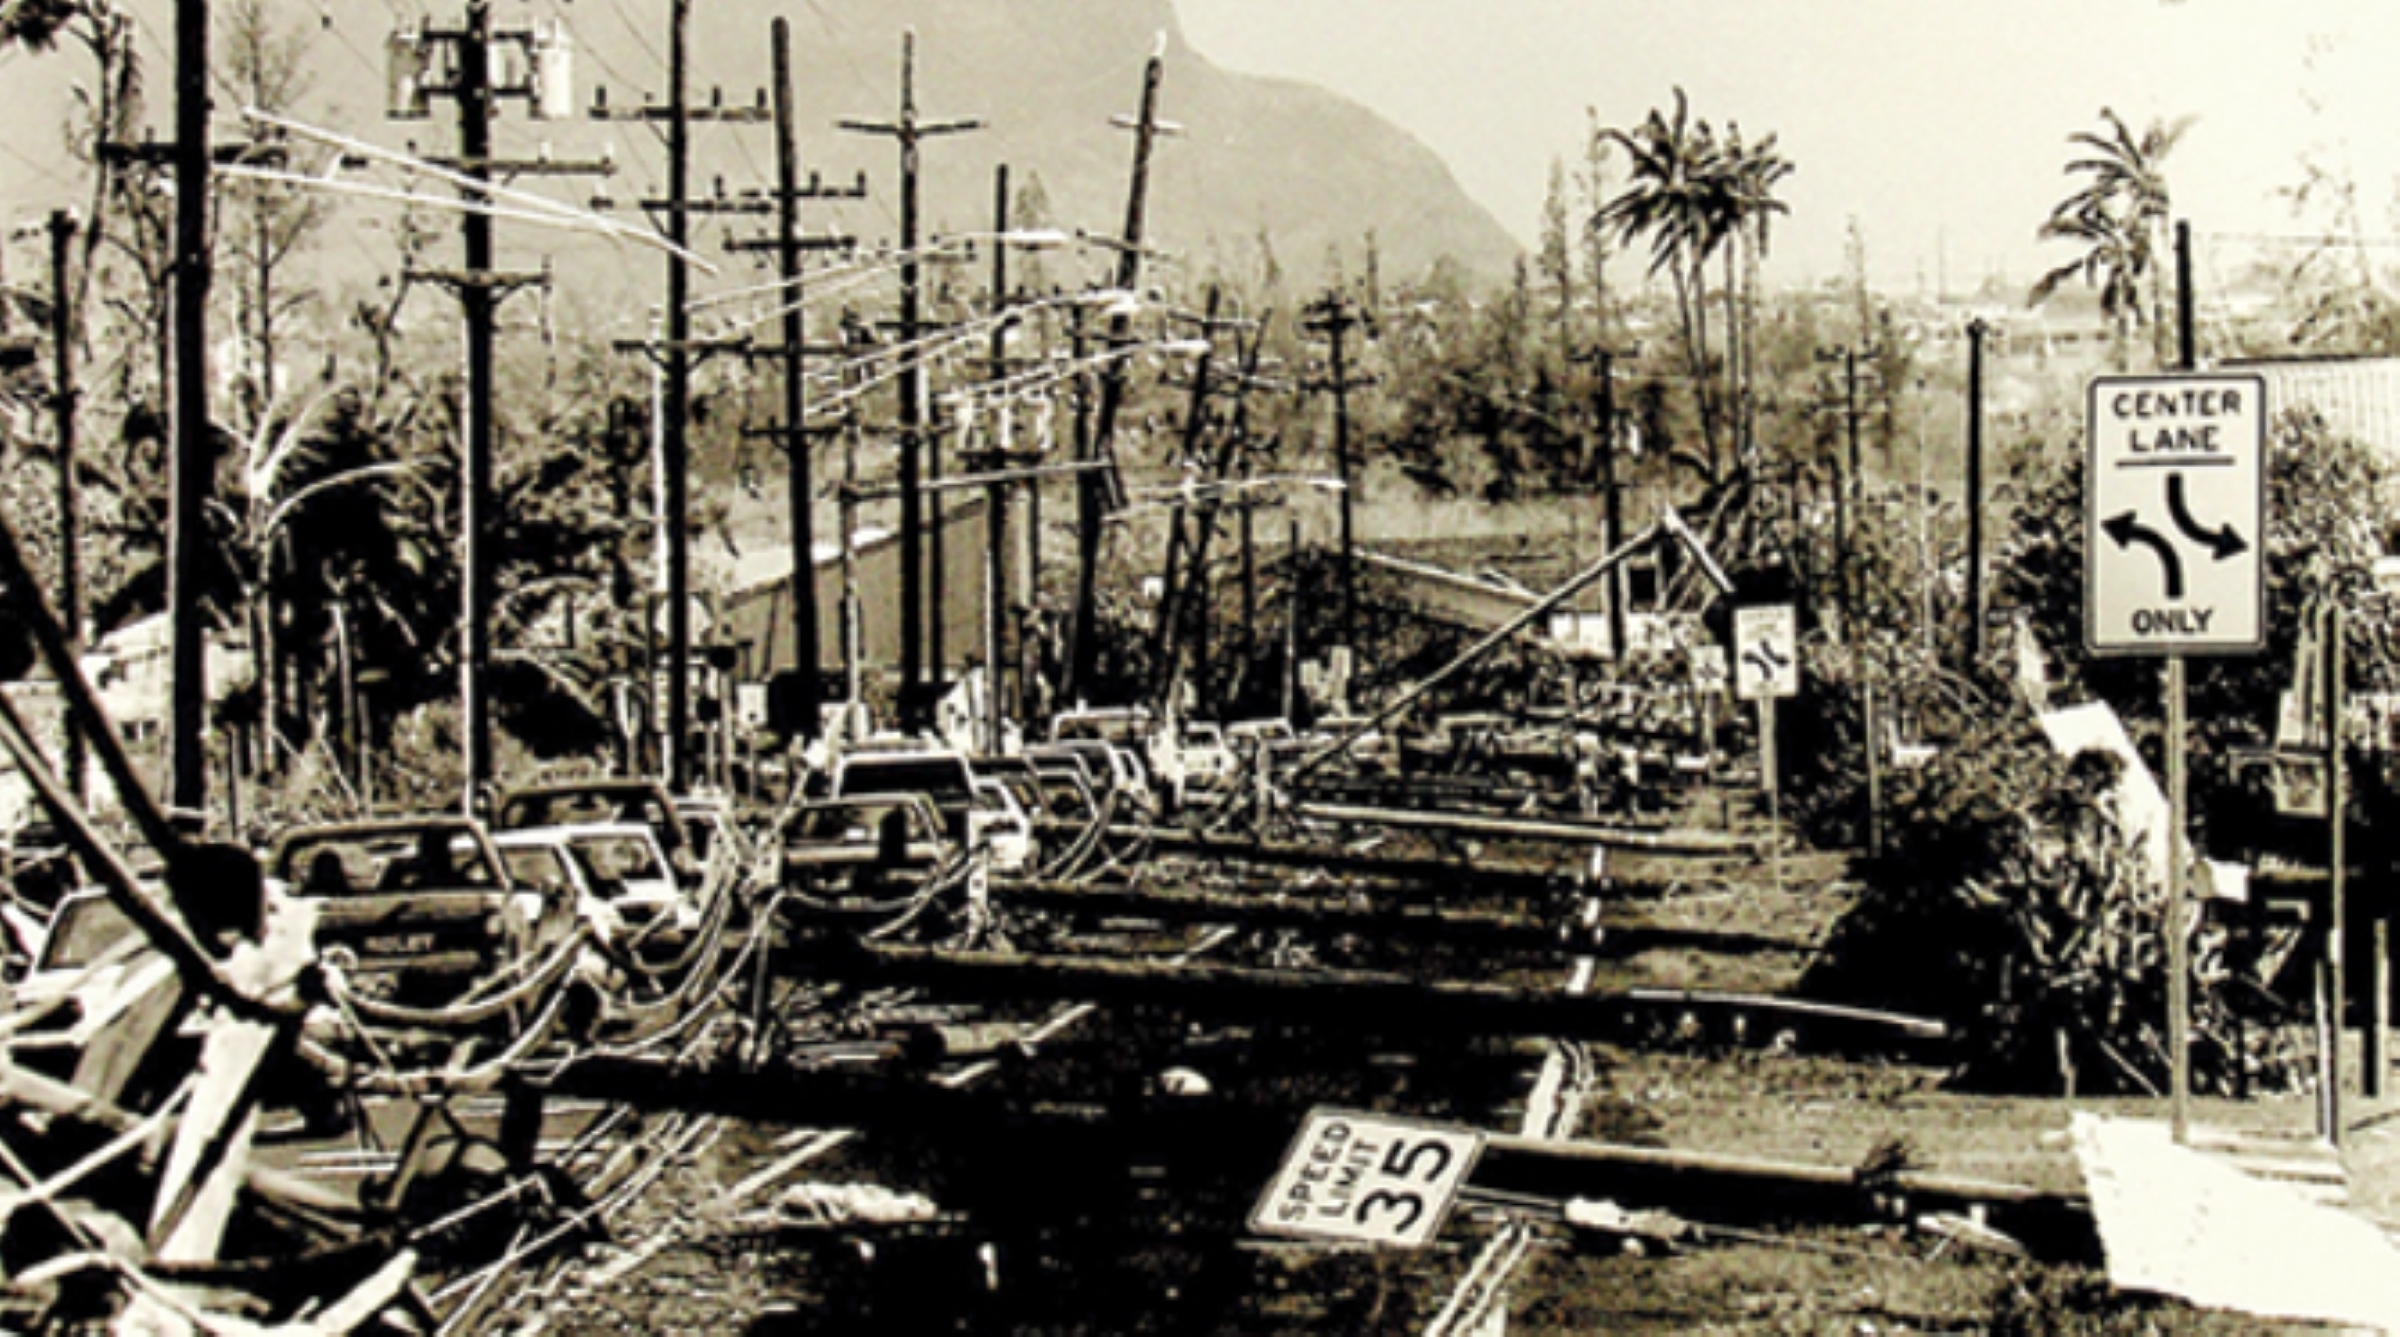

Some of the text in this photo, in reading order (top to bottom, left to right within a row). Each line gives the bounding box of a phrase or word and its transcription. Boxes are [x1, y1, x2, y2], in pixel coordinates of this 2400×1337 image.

[2111, 389, 2241, 418] CENTER
[2129, 425, 2219, 452] LANE
[2132, 608, 2213, 636] ONLY
[1278, 1122, 1351, 1221] SPEED
[1317, 1138, 1380, 1217] LIMIT
[1355, 1138, 1453, 1234] 35
